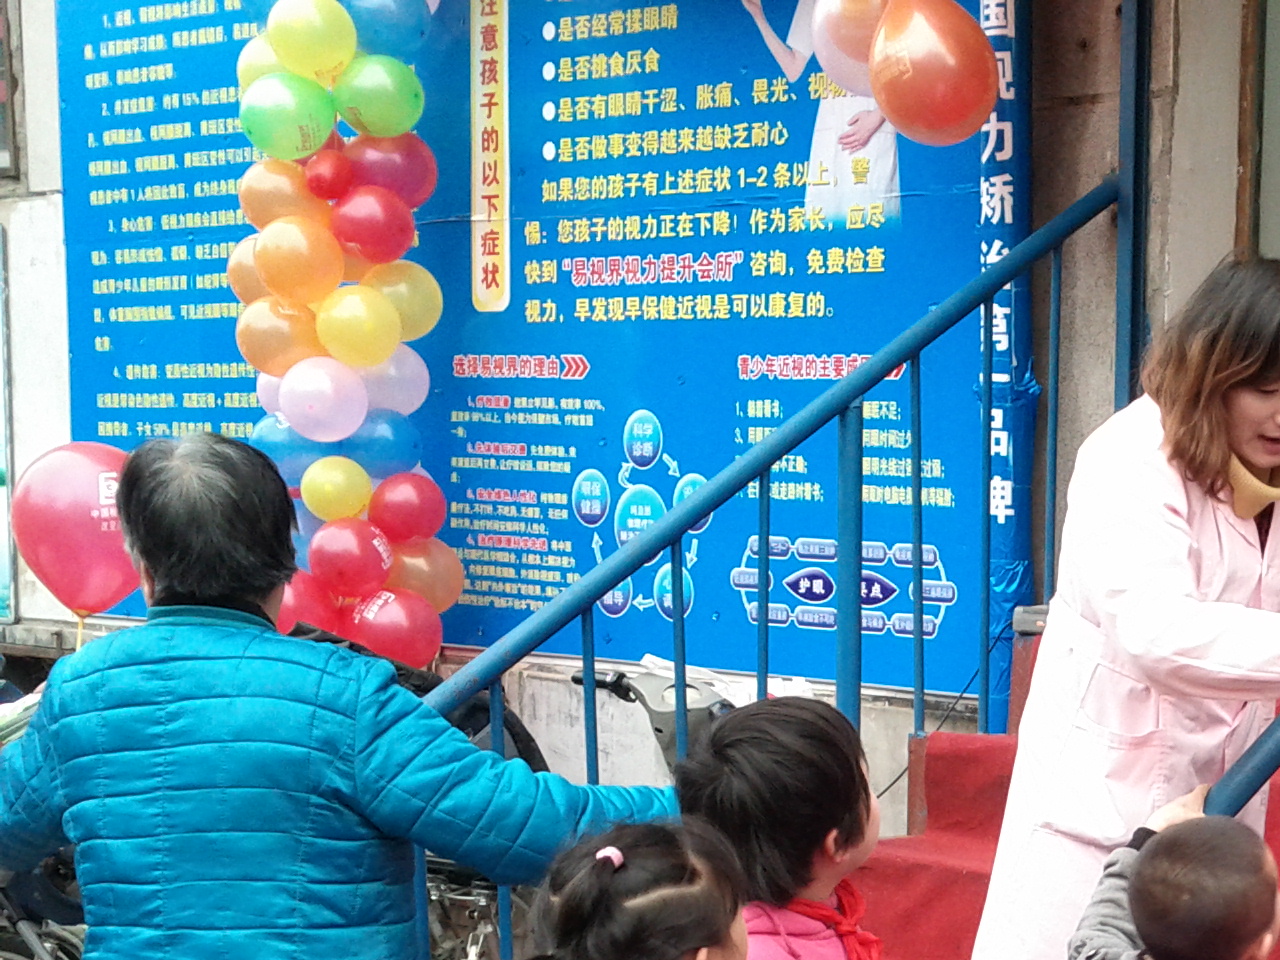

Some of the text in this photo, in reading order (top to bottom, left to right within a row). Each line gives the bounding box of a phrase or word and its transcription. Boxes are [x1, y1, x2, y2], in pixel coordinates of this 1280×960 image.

[558, 4, 678, 42] 是否经常揉眼睛
[558, 47, 660, 82] 是否挑食厌食
[480, 0, 500, 290] 注意孩子的以下症状
[558, 120, 789, 162] 是否做事变得越来越缺乏耐心
